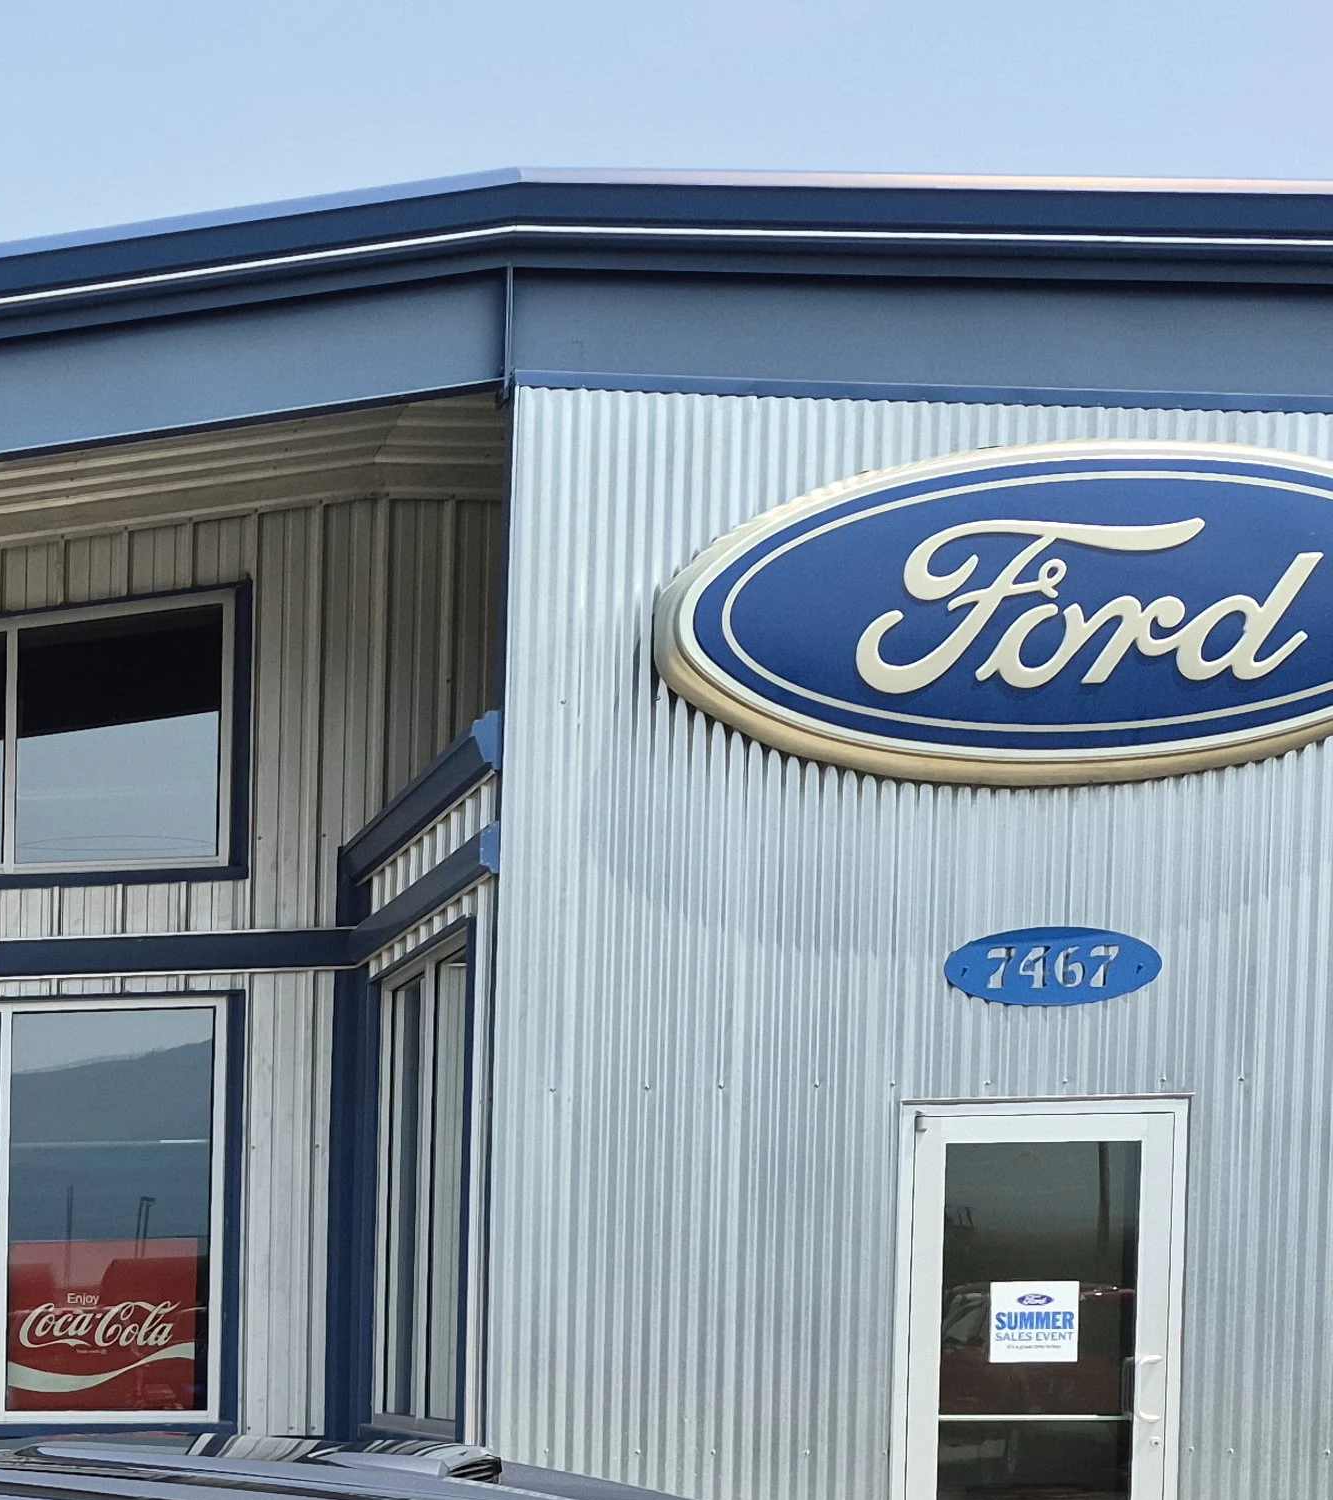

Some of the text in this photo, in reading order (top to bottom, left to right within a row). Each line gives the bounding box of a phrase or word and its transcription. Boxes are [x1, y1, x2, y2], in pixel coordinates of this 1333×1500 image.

[855, 516, 1324, 694] Ford
[986, 944, 1120, 989] 7467
[66, 1293, 100, 1305] Enjoy
[19, 1300, 182, 1348] Coca-Cola
[995, 1311, 1075, 1330] SUMMER
[995, 1331, 1074, 1341] SALES EVENT
